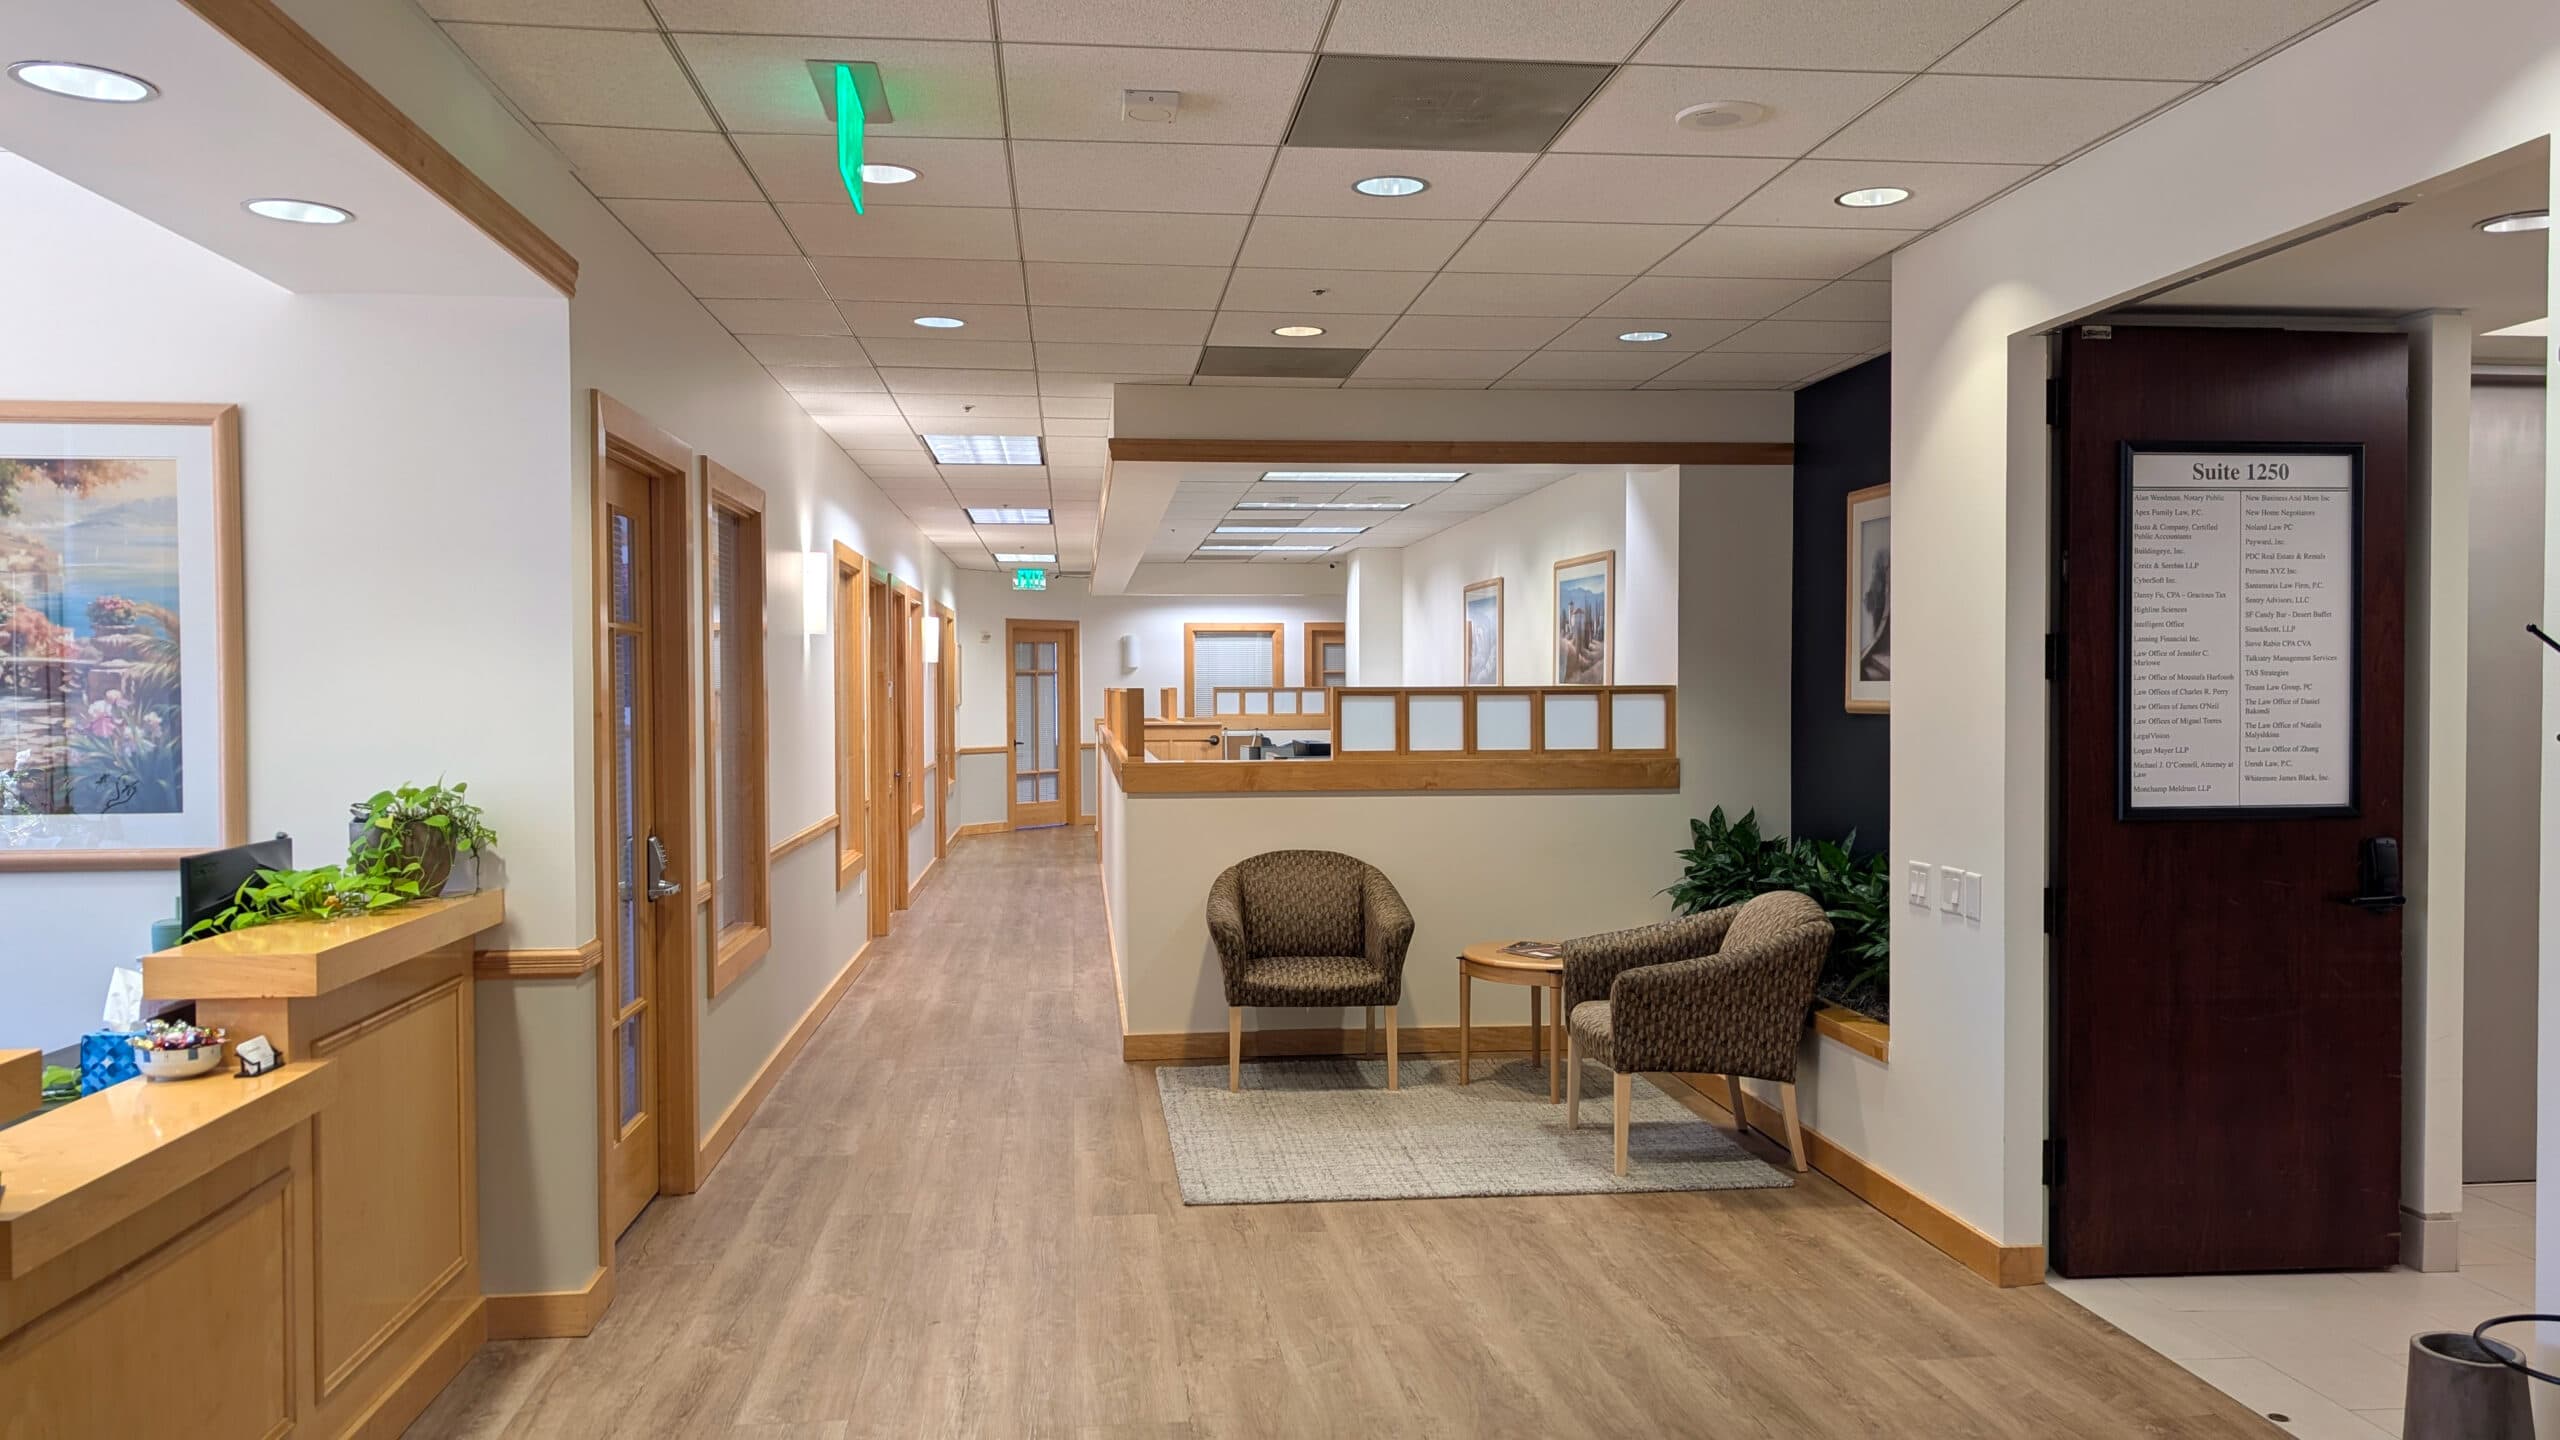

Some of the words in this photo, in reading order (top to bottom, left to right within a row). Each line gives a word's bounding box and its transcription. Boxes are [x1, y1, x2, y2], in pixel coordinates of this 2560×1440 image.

[2192, 462, 2240, 481] Suite
[2247, 463, 2290, 481] 1250
[2183, 494, 2204, 503] Notary
[2205, 493, 2225, 501] Public
[2302, 494, 2319, 502] More
[2133, 508, 2151, 518] Apex
[2151, 508, 2173, 518] Family
[2174, 508, 2190, 517] Law,
[2159, 523, 2190, 533] Company,
[2191, 523, 2218, 531] Certified
[2245, 523, 2267, 531] Noland
[2268, 523, 2282, 531] Law
[2134, 532, 2154, 540] Public
[2154, 532, 2192, 540] Accountants
[2245, 552, 2260, 560] PDC
[2261, 552, 2275, 560] Real
[2276, 552, 2295, 560] Estate
[2185, 561, 2199, 569] LLP
[2270, 567, 2286, 575] XYZ
[2133, 576, 2165, 586] CyberSoft
[2279, 581, 2293, 589] Law
[2294, 581, 2311, 590] Firm,
[2312, 581, 2325, 589] P.C.
[2133, 591, 2154, 601] Danny
[2166, 591, 2181, 599] CPA
[2265, 596, 2294, 605] Advisors,
[2295, 596, 2309, 604] LLC
[2133, 605, 2160, 615] Highline
[2160, 605, 2187, 613] Sciences
[2254, 610, 2274, 620] Candy
[2275, 610, 2287, 618] Bar
[2313, 610, 2332, 618] Buffet
[2134, 620, 2164, 630] Intelligent
[2165, 620, 2184, 628] Office
[2282, 625, 2295, 633] LLP
[2159, 634, 2188, 642] Financial
[2282, 639, 2296, 647] CPA
[2297, 639, 2312, 647] CVA
[2132, 649, 2147, 657] Law
[2147, 649, 2167, 657] Office
[2176, 649, 2201, 657] Jennifer
[2272, 654, 2311, 663] Management
[2133, 673, 2147, 681] Law
[2148, 673, 2168, 681] Office
[2260, 668, 2289, 678] Strategies
[2266, 683, 2280, 691] Law
[2281, 683, 2302, 692] Group,
[2133, 688, 2147, 696] Law
[2148, 688, 2170, 696] Offices
[2179, 688, 2203, 696] Charles
[2212, 688, 2229, 697] Perry
[2245, 697, 2257, 705] The
[2272, 697, 2292, 705] Office
[2300, 697, 2320, 705] Daniel
[2133, 702, 2147, 710] Law
[2148, 702, 2170, 710] Offices
[2179, 702, 2198, 710] James
[2132, 717, 2147, 725] Law
[2147, 717, 2170, 725] Offices
[2179, 717, 2202, 726] Miguel
[2244, 721, 2257, 729] The
[2257, 721, 2271, 729] Law
[2272, 721, 2291, 729] Office
[2132, 746, 2152, 756] Logan
[2153, 746, 2174, 756] Mayer
[2175, 746, 2189, 754] LLP
[2244, 745, 2256, 753] The
[2257, 745, 2271, 753] Law
[2272, 745, 2291, 753] Office
[2299, 745, 2319, 754] Zhang
[2132, 760, 2158, 768] Michael
[2200, 760, 2228, 770] Attorney
[2264, 760, 2279, 769] Law,
[2280, 759, 2293, 767] P.C.
[2132, 770, 2147, 778] Law
[2278, 774, 2297, 782] James
[2298, 774, 2317, 783] Black,
[2197, 784, 2211, 792] LLP
